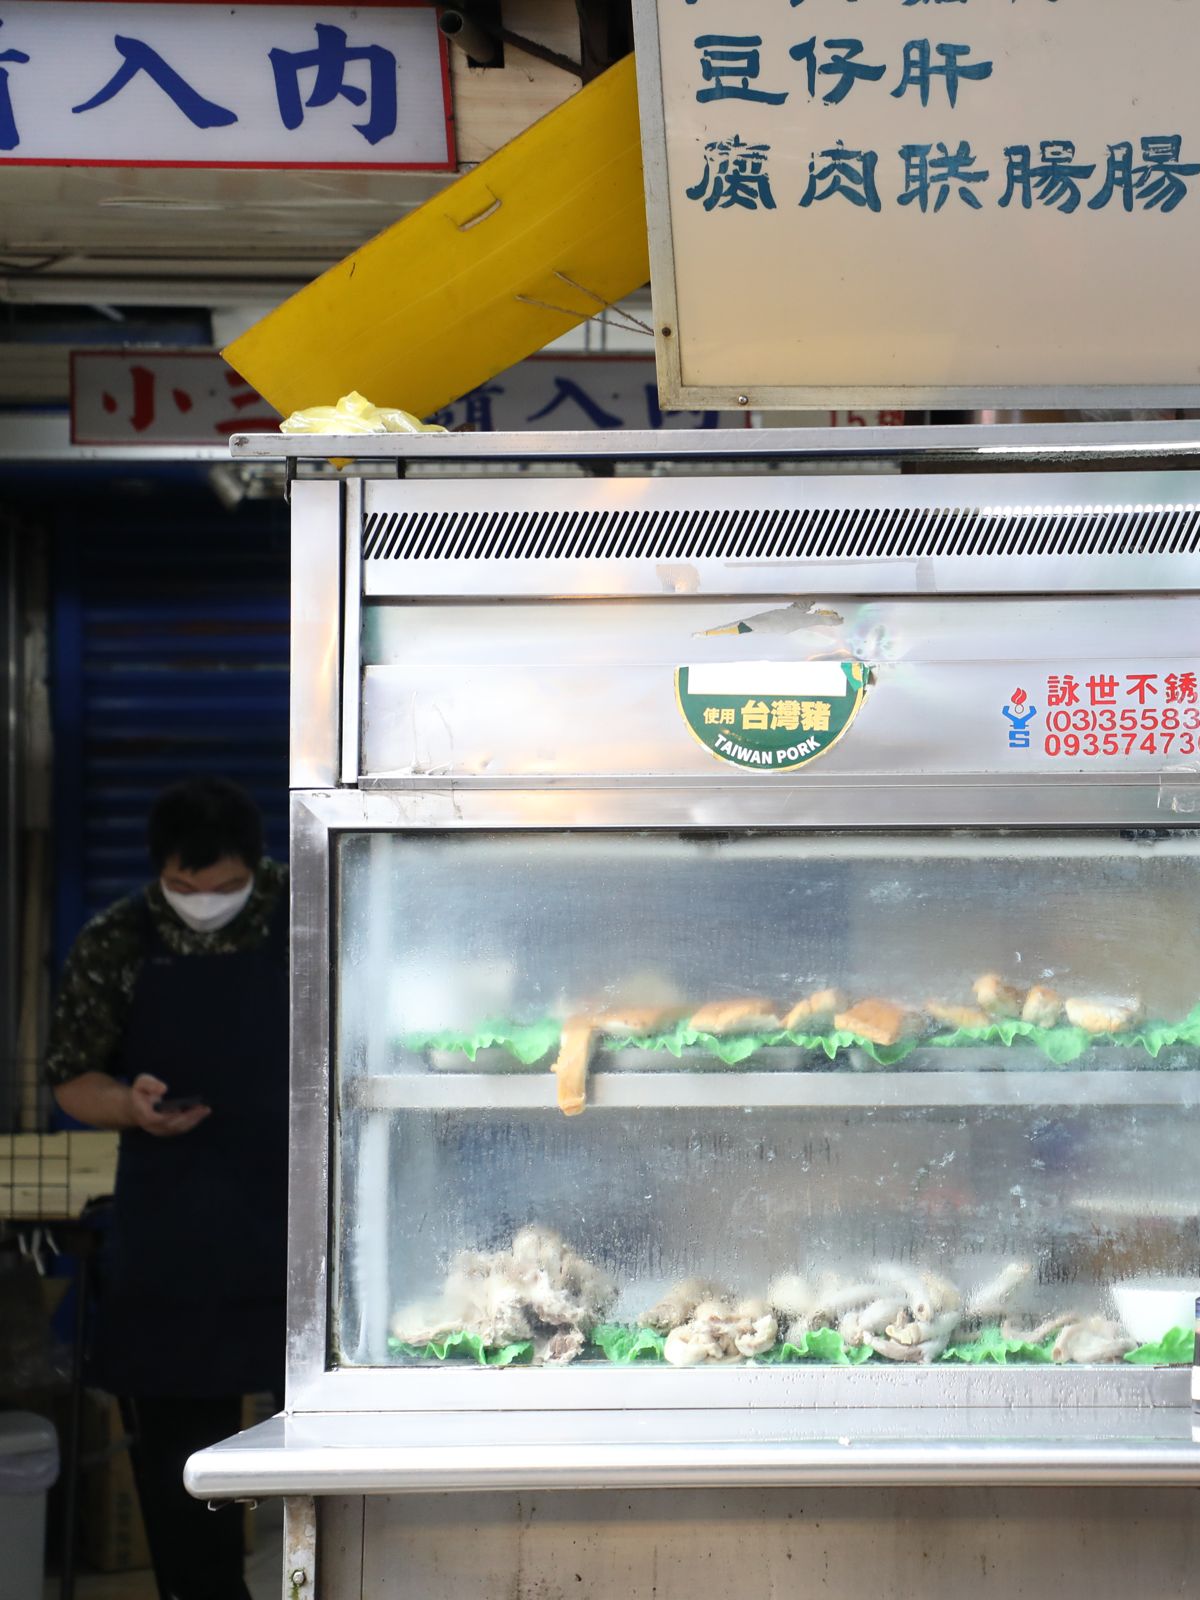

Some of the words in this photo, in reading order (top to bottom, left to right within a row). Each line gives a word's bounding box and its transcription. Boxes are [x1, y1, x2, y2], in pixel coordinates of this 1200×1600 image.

[703, 707, 735, 724] 使用
[741, 700, 830, 731] 台灣豬
[714, 734, 772, 764] TAIWAN
[777, 736, 821, 764] PORK
